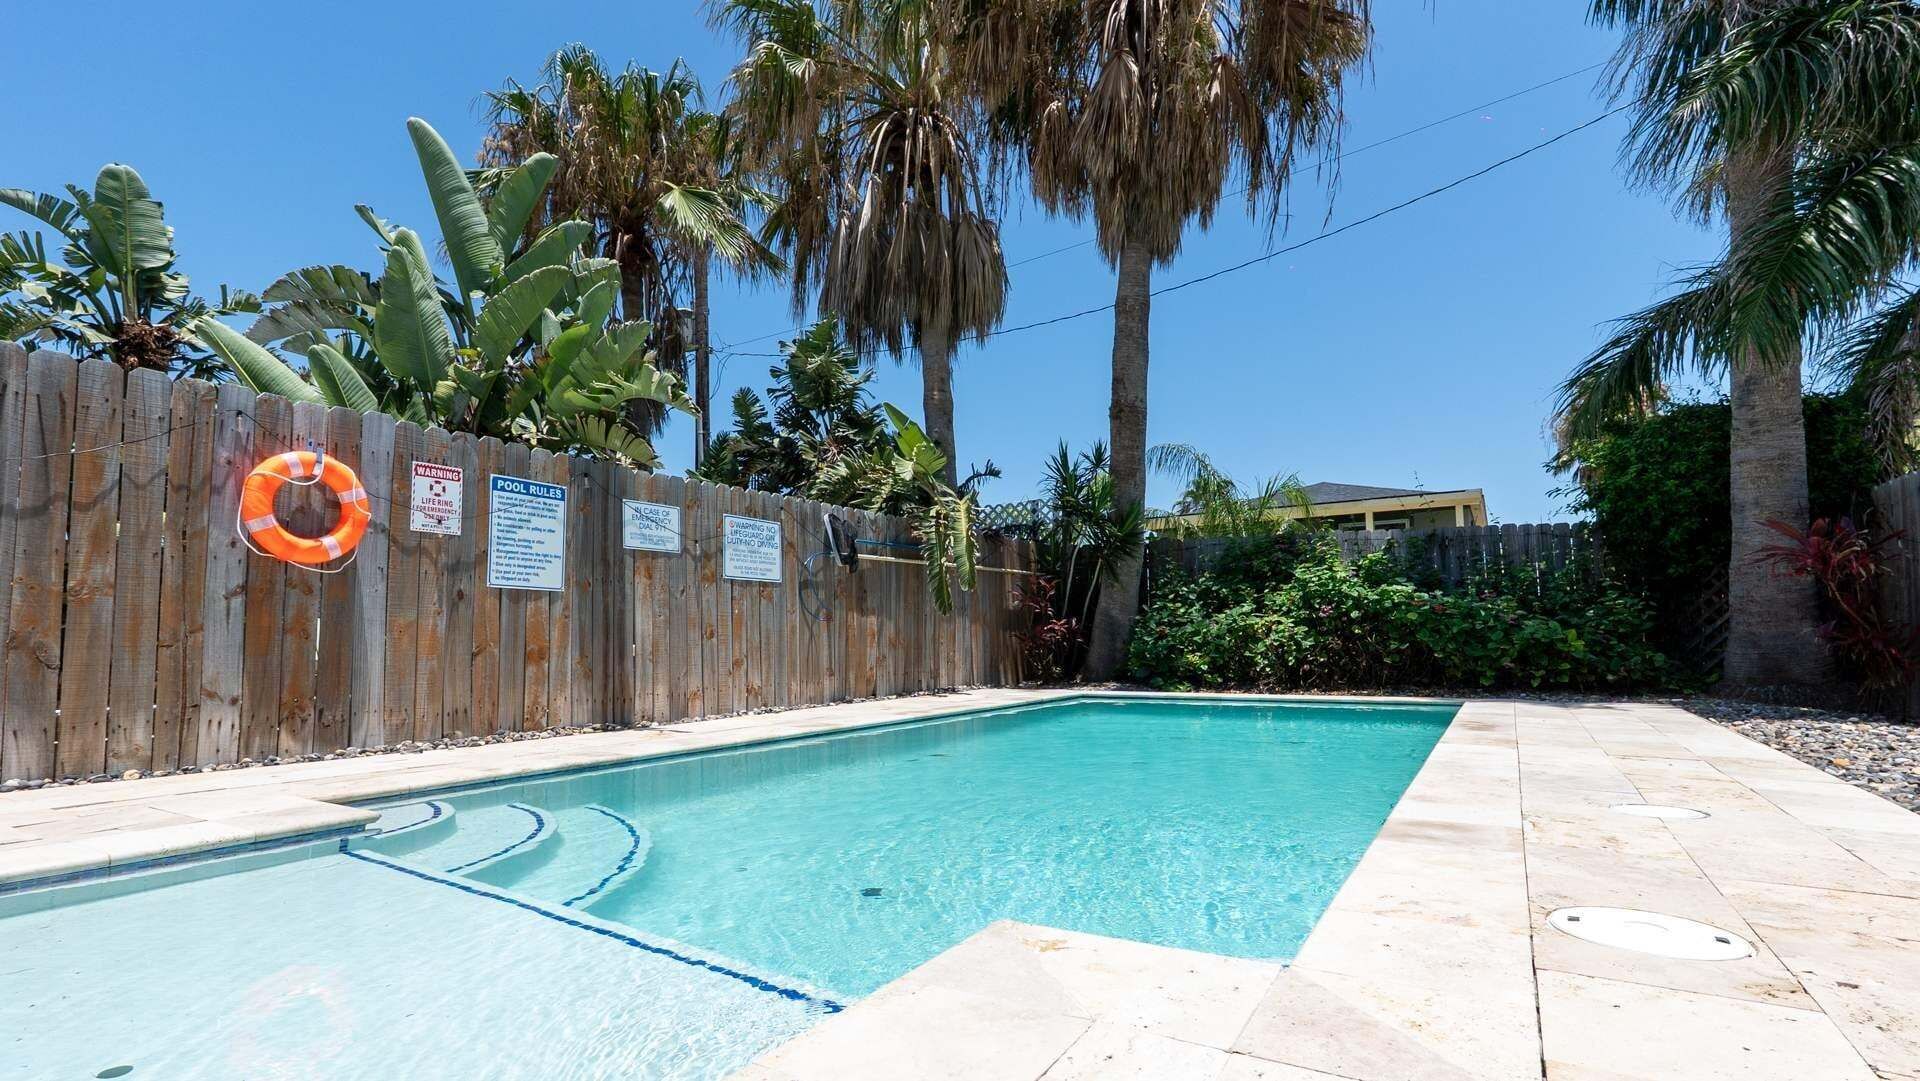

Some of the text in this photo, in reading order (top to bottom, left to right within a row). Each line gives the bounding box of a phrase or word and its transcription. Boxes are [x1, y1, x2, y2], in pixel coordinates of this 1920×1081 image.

[416, 466, 458, 480] WARNING
[498, 480, 562, 498] POOL RULES
[422, 497, 453, 507] LIFE RING
[427, 506, 457, 514] EMERGENCY
[644, 508, 660, 516] CASE
[632, 514, 671, 525] EMERGENCY
[736, 522, 764, 532] WARNING
[731, 530, 764, 540] LIFEGUARD
[757, 540, 778, 550] DIVING
